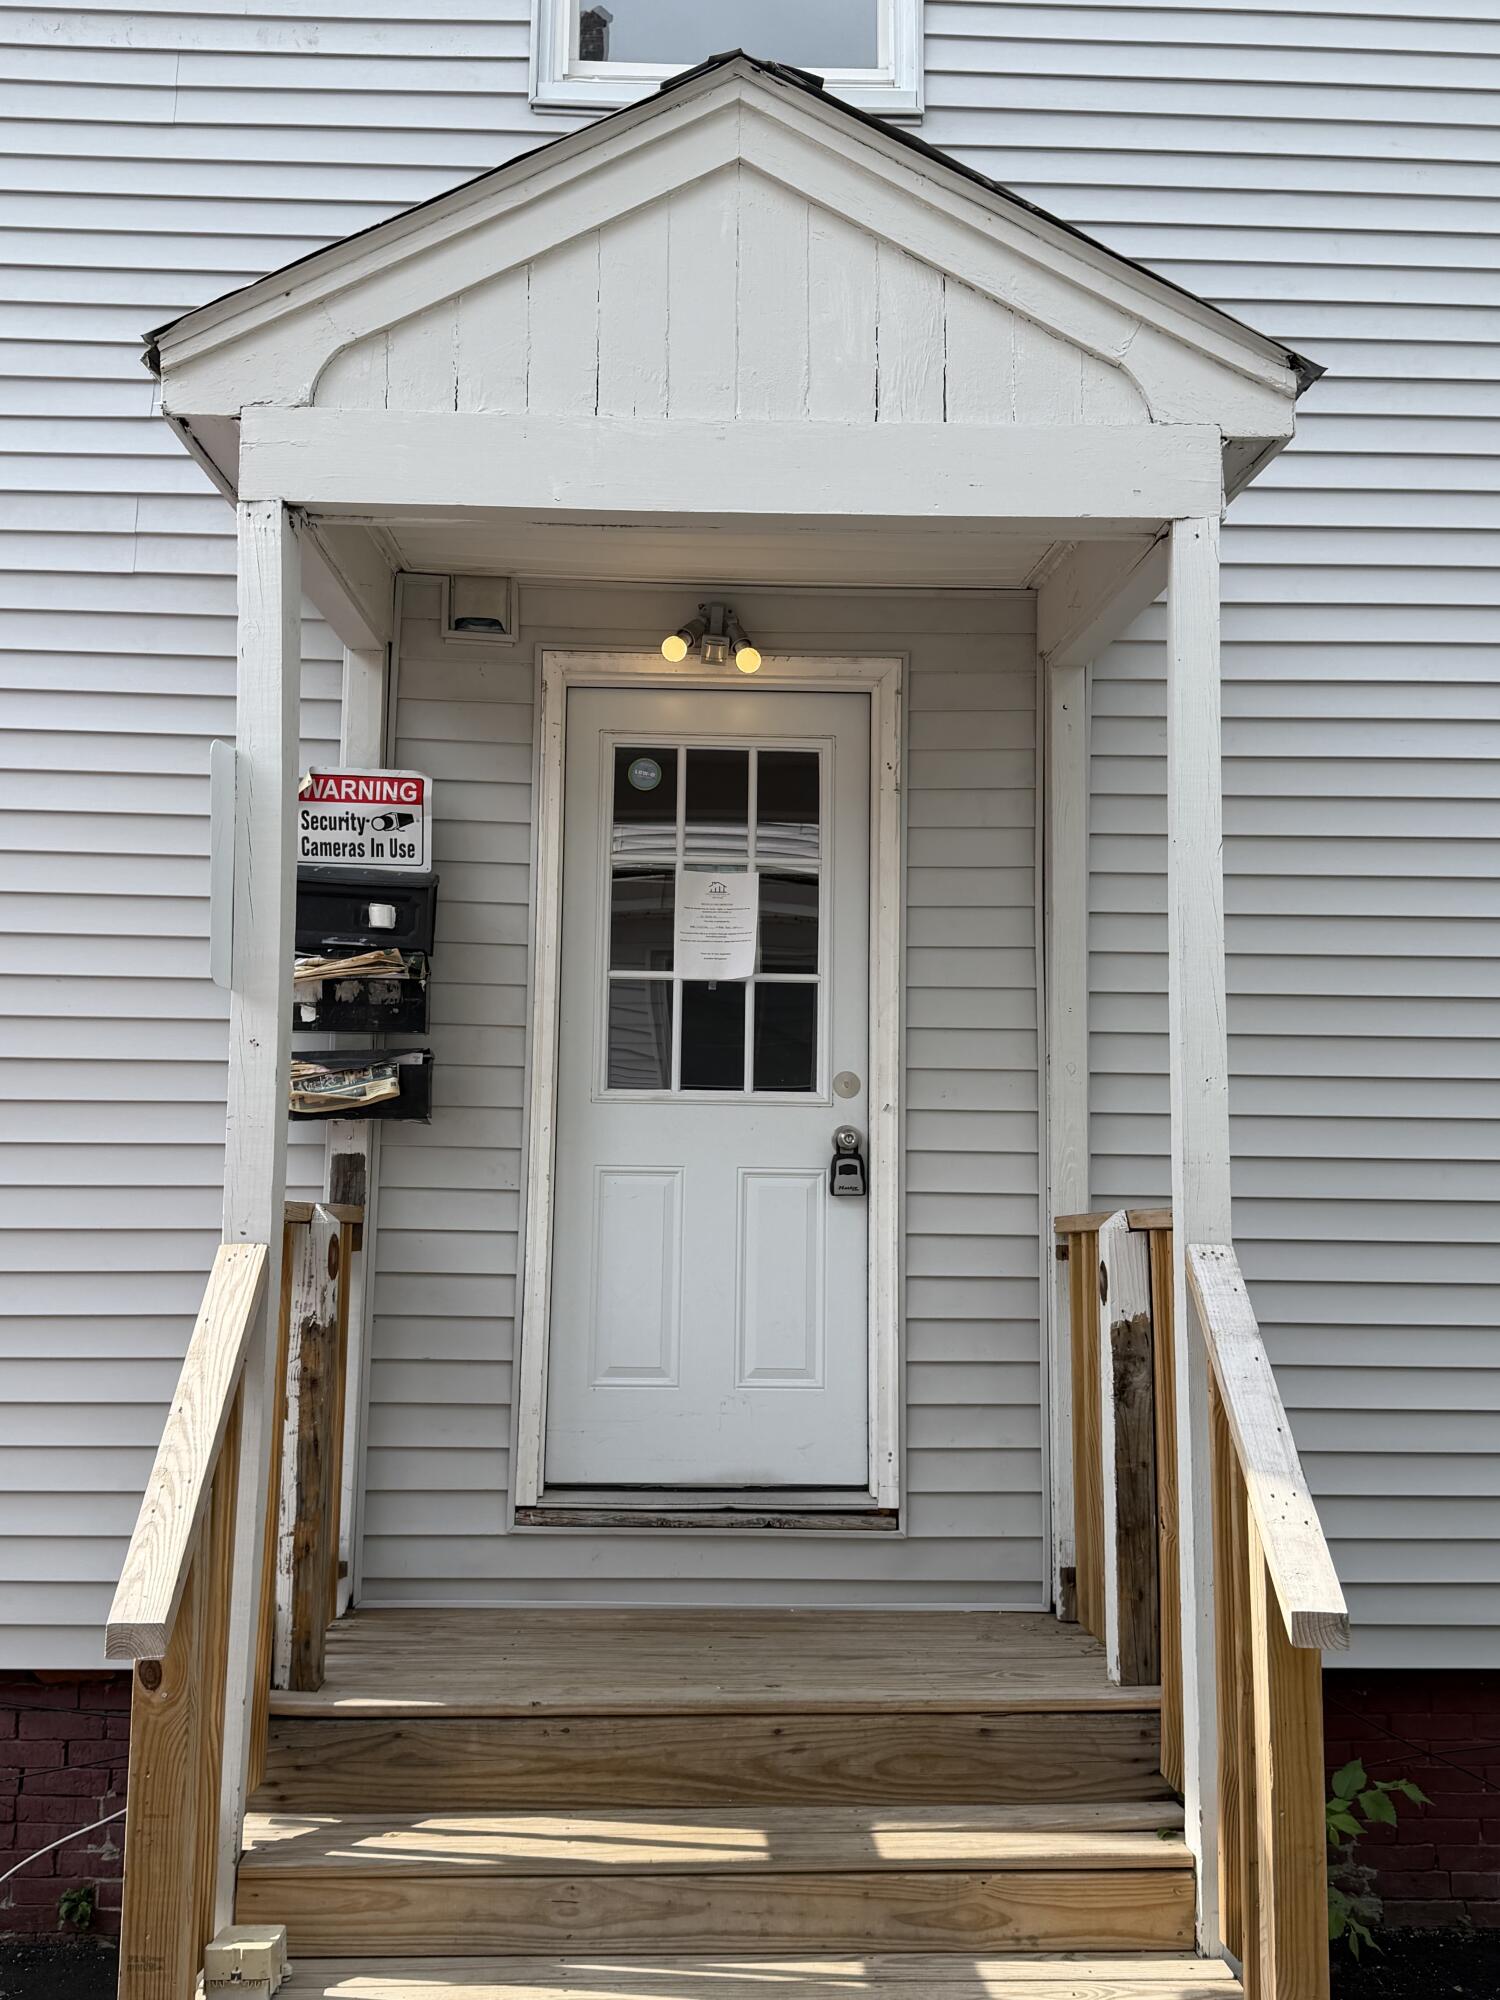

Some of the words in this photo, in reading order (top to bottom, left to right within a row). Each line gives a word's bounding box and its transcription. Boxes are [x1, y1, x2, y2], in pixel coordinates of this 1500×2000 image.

[303, 779, 417, 801] WARNING
[301, 809, 366, 836] Security
[301, 836, 365, 857] Cameras
[370, 837, 384, 858] In
[389, 838, 416, 859] Use
